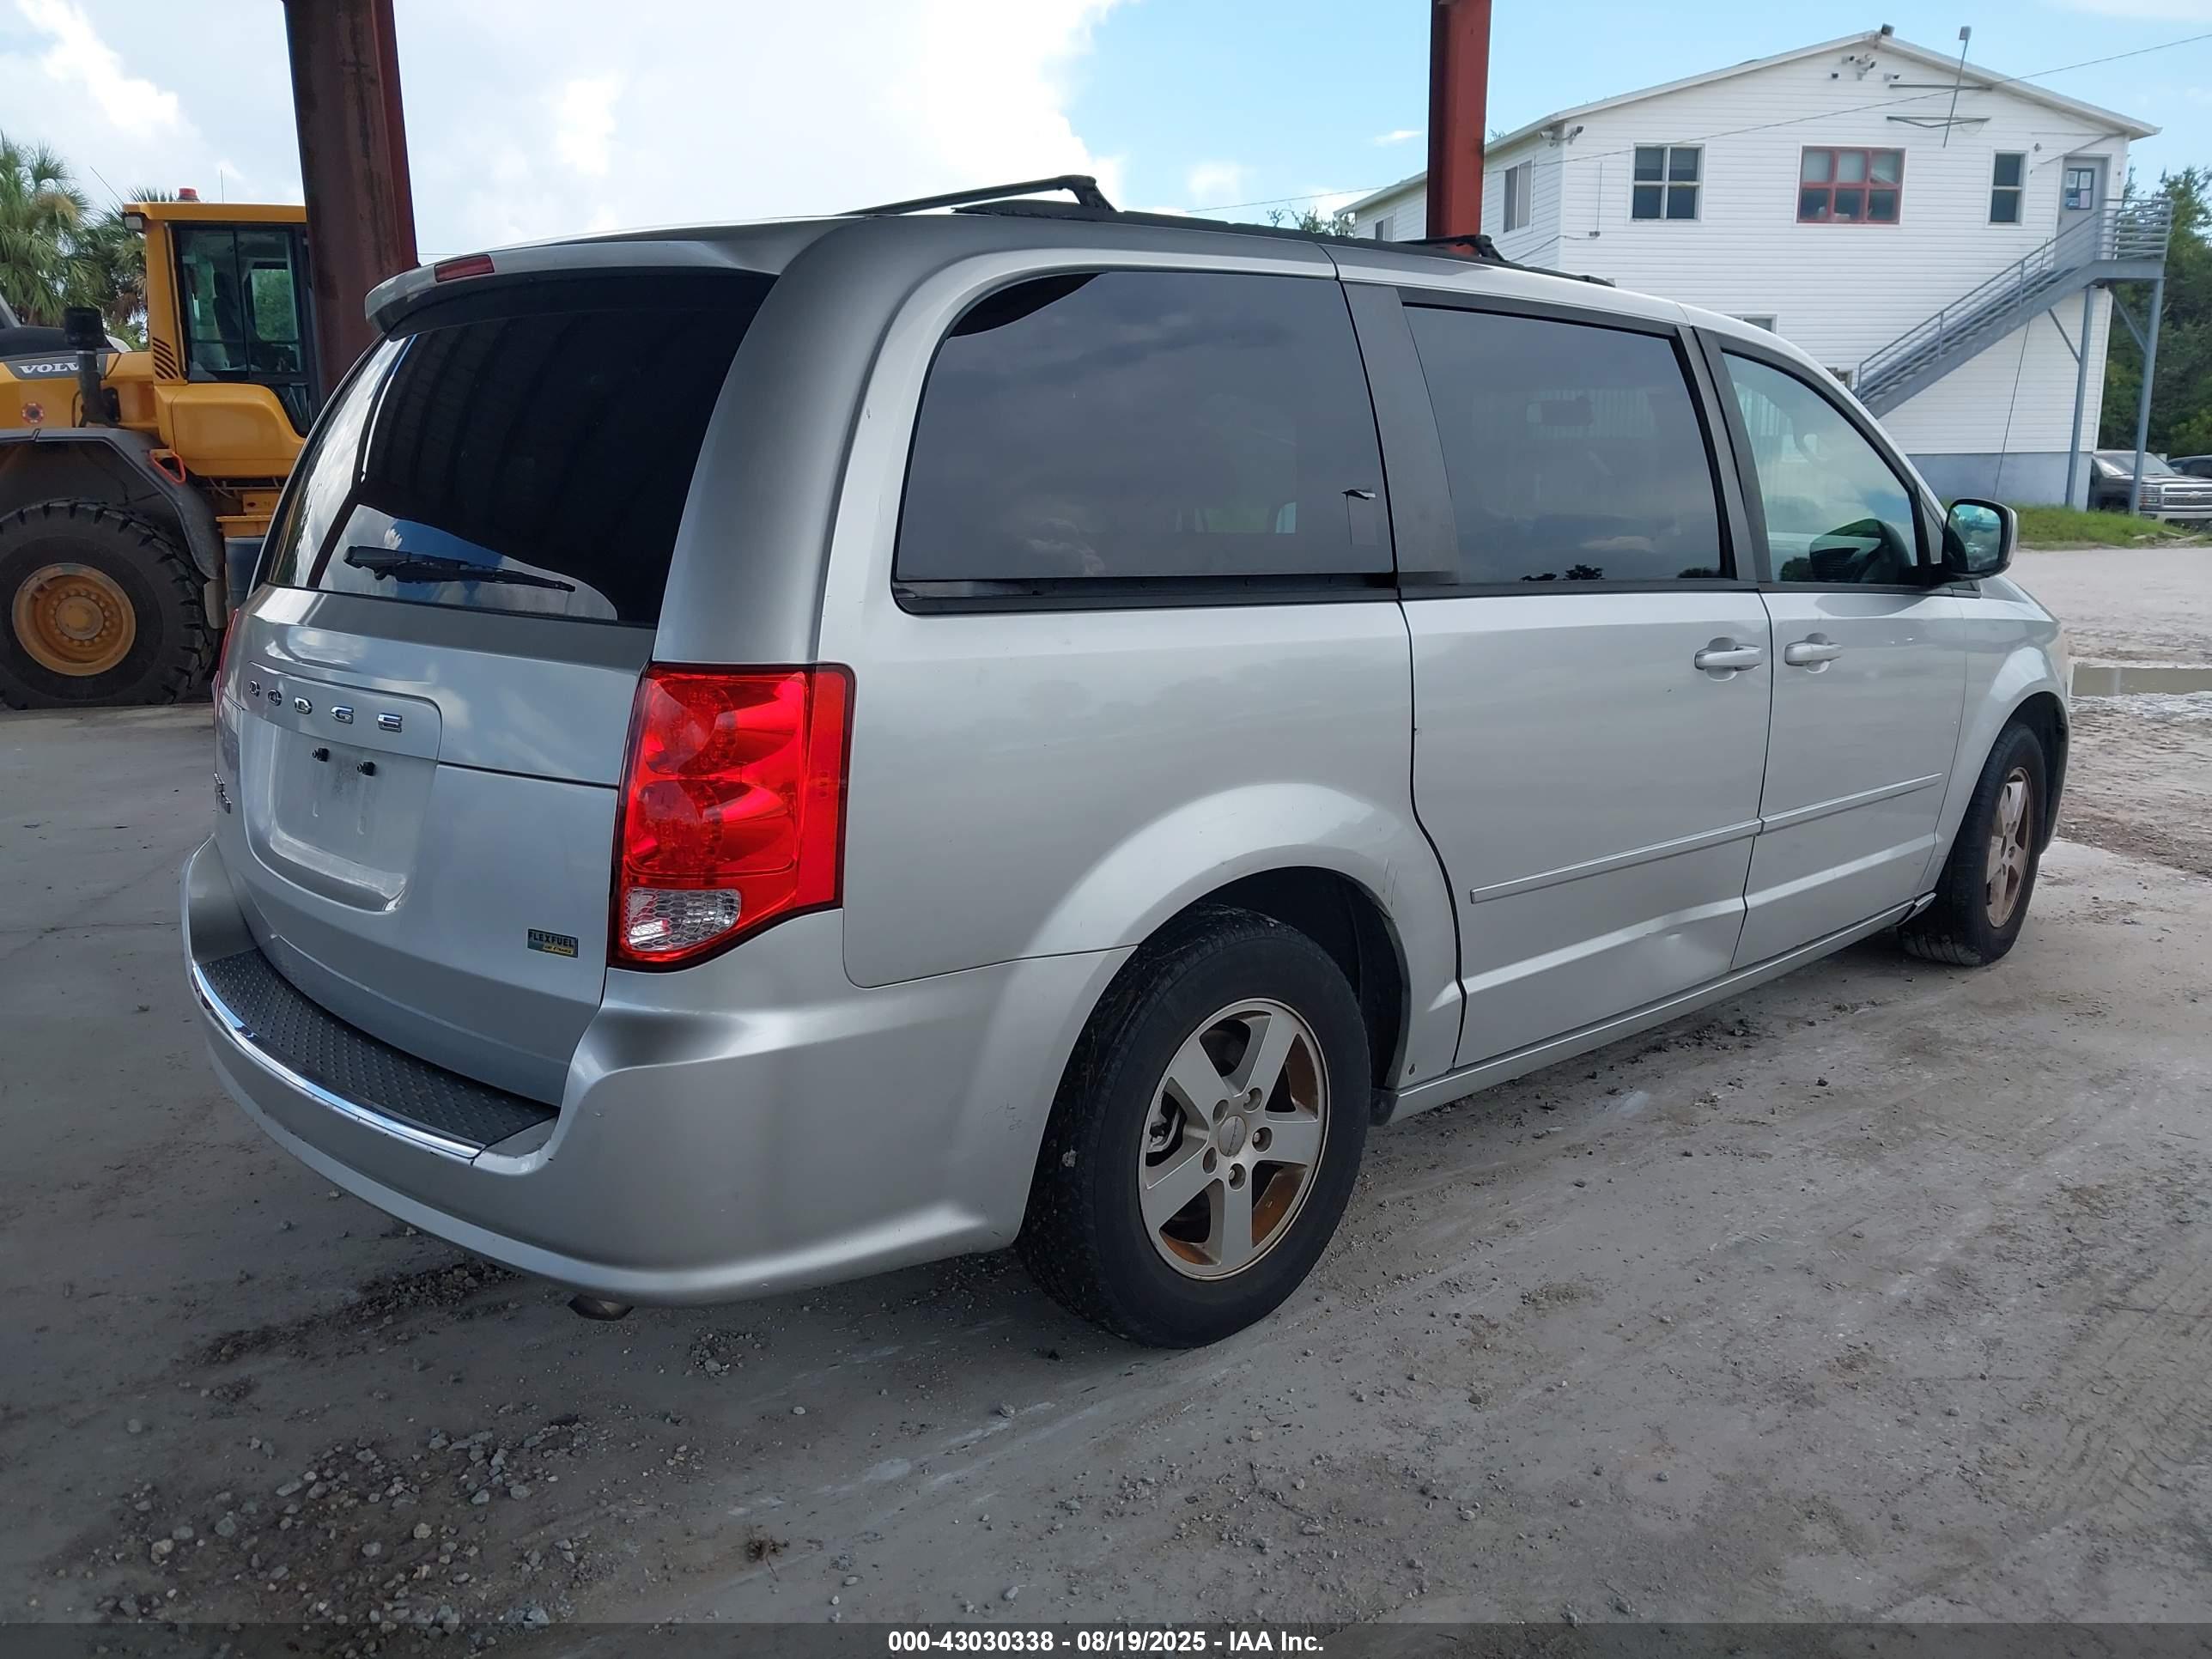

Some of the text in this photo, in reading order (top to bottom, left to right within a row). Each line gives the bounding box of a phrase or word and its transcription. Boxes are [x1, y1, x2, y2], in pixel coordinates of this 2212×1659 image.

[18, 362, 83, 374] VOLV
[249, 680, 403, 733] DODGE
[528, 931, 574, 948] FLEXFUEL
